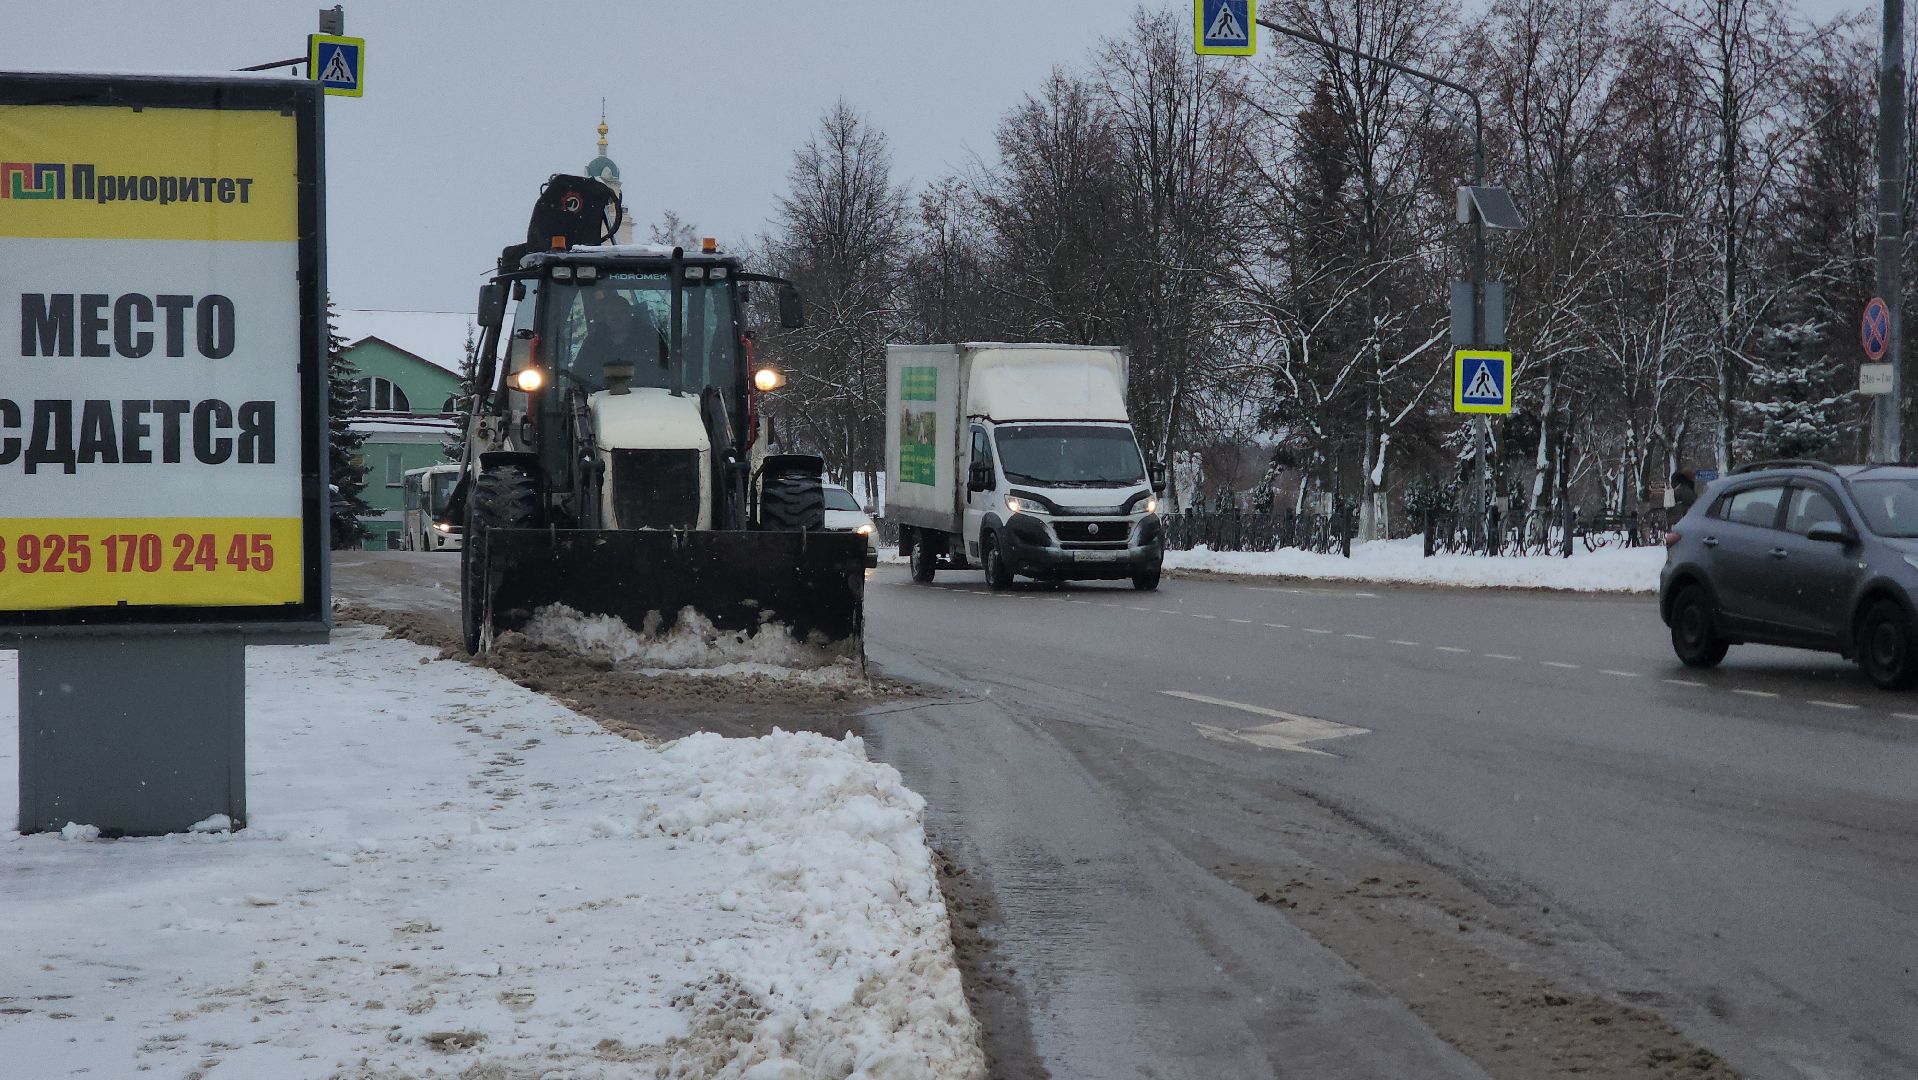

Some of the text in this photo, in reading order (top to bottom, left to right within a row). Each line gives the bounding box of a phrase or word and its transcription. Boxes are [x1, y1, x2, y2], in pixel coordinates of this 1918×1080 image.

[73, 164, 253, 205] Приоритет
[21, 292, 236, 359] МЕСТО
[0, 398, 276, 475] СДАЕТСЯ
[17, 534, 91, 574] 925
[101, 533, 162, 573] 170
[172, 533, 218, 572] 24
[226, 533, 274, 572] 45
